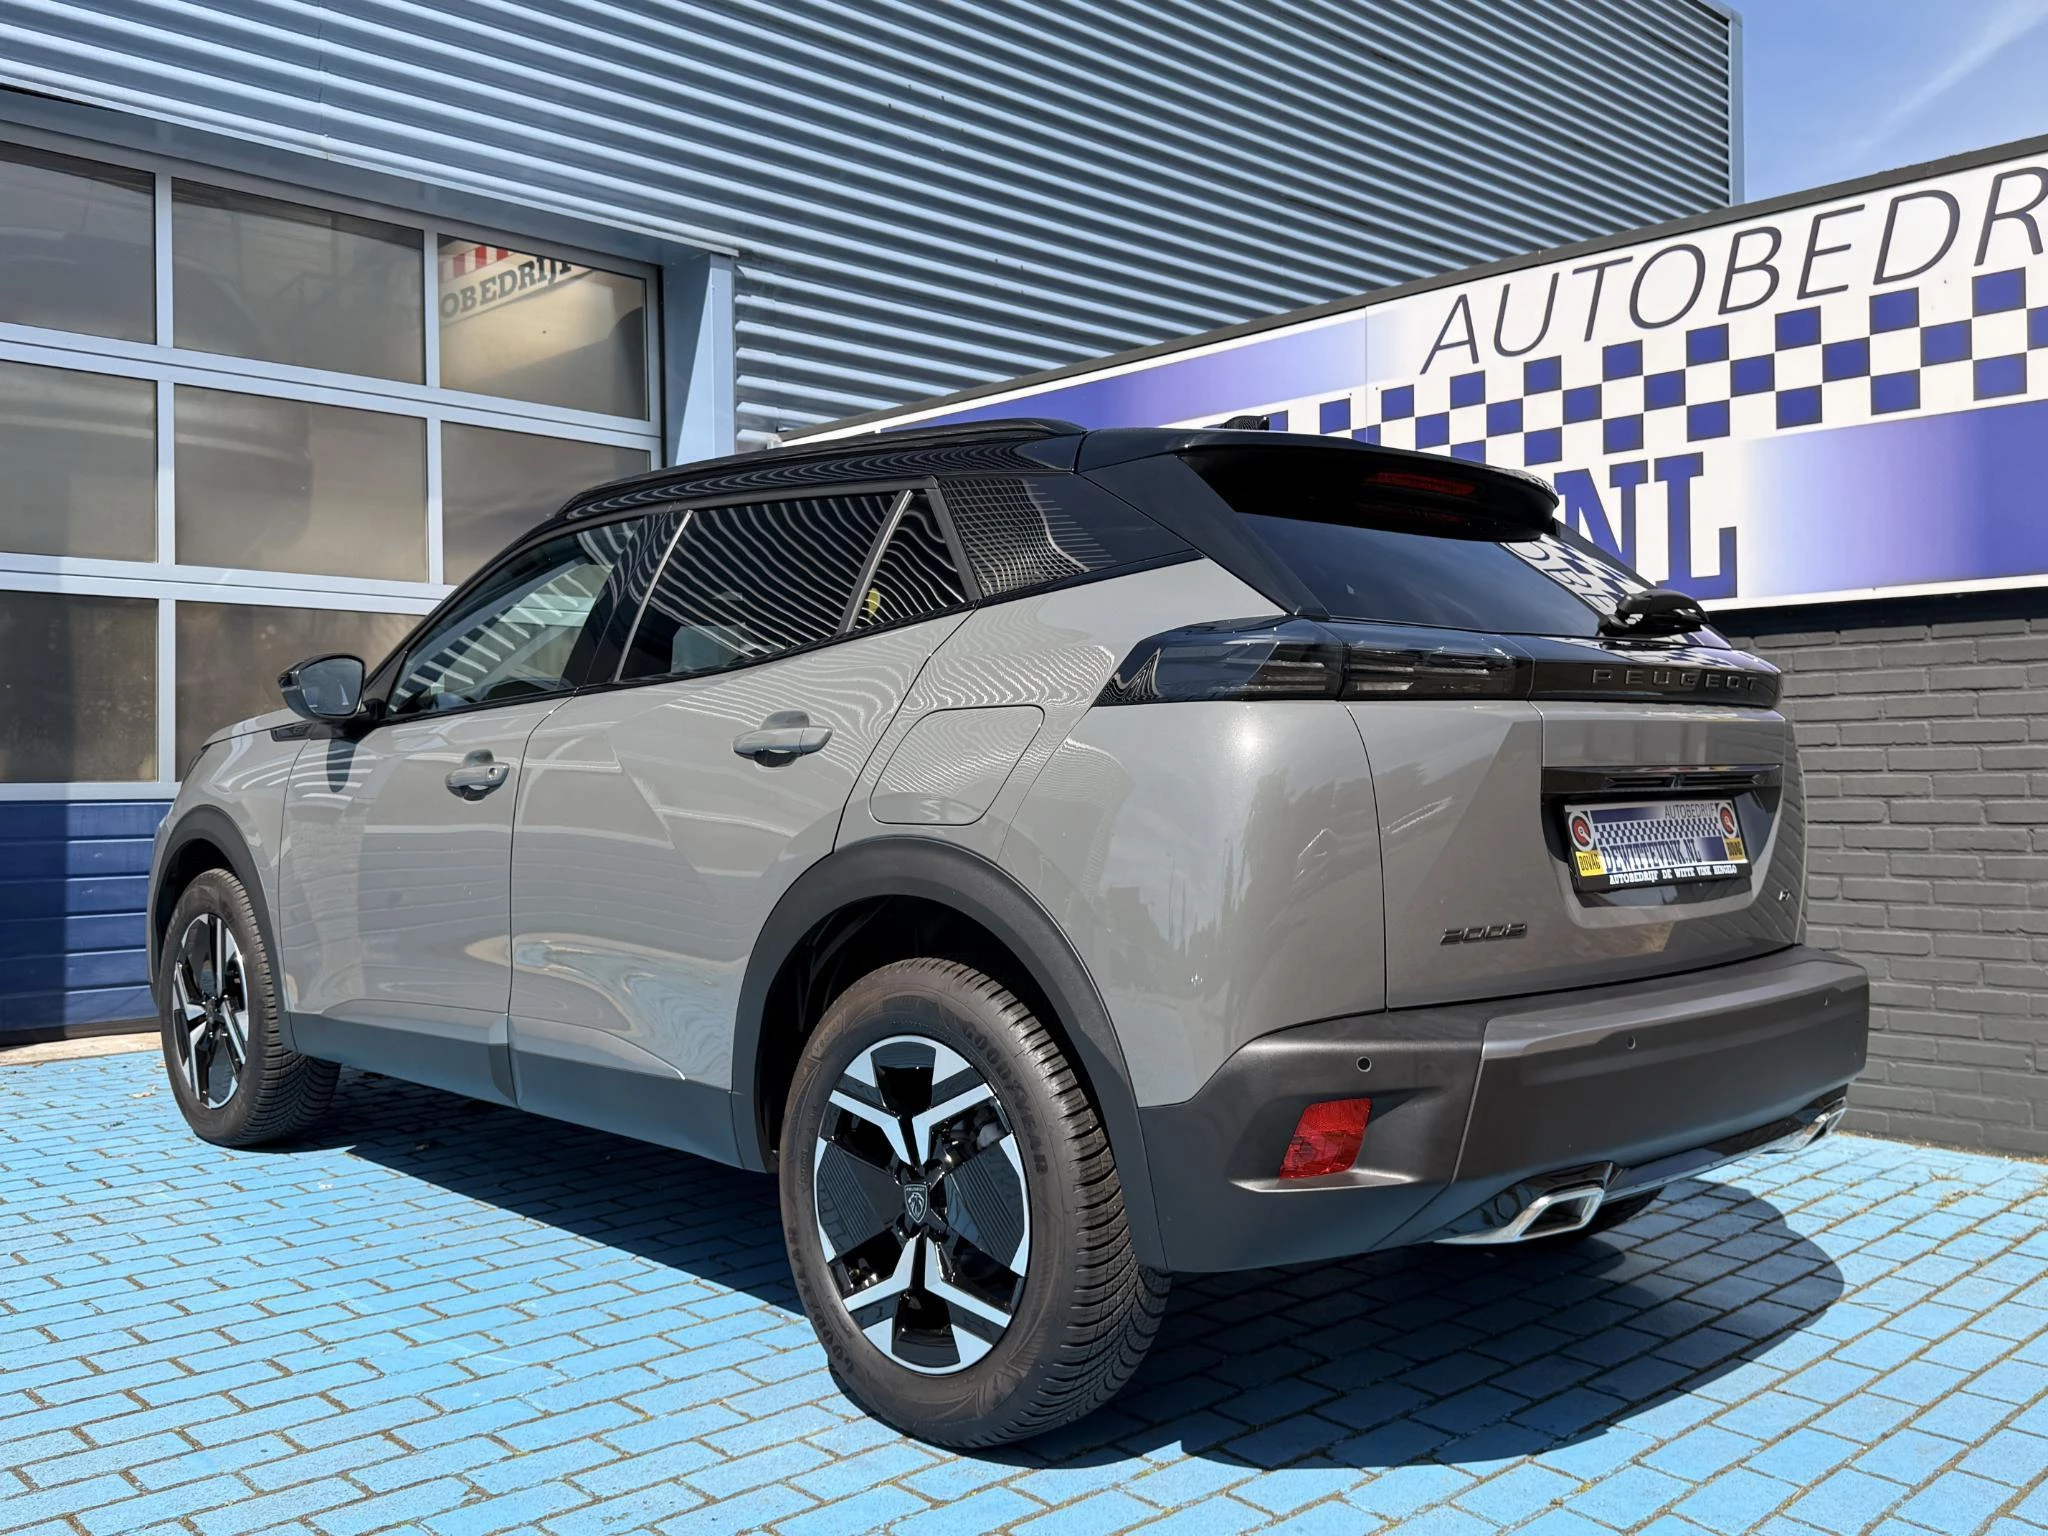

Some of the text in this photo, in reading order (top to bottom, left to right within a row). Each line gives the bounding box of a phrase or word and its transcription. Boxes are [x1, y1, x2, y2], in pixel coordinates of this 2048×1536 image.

[1420, 165, 2048, 376] AUTOBEDR
[1591, 668, 1759, 691] PEUGEOT
[1664, 802, 1716, 819] AUTOBEDRIJF
[1609, 869, 1659, 885] AUTOBEDRIJF
[1661, 869, 1673, 880] DE
[1440, 923, 1527, 945] 2008
